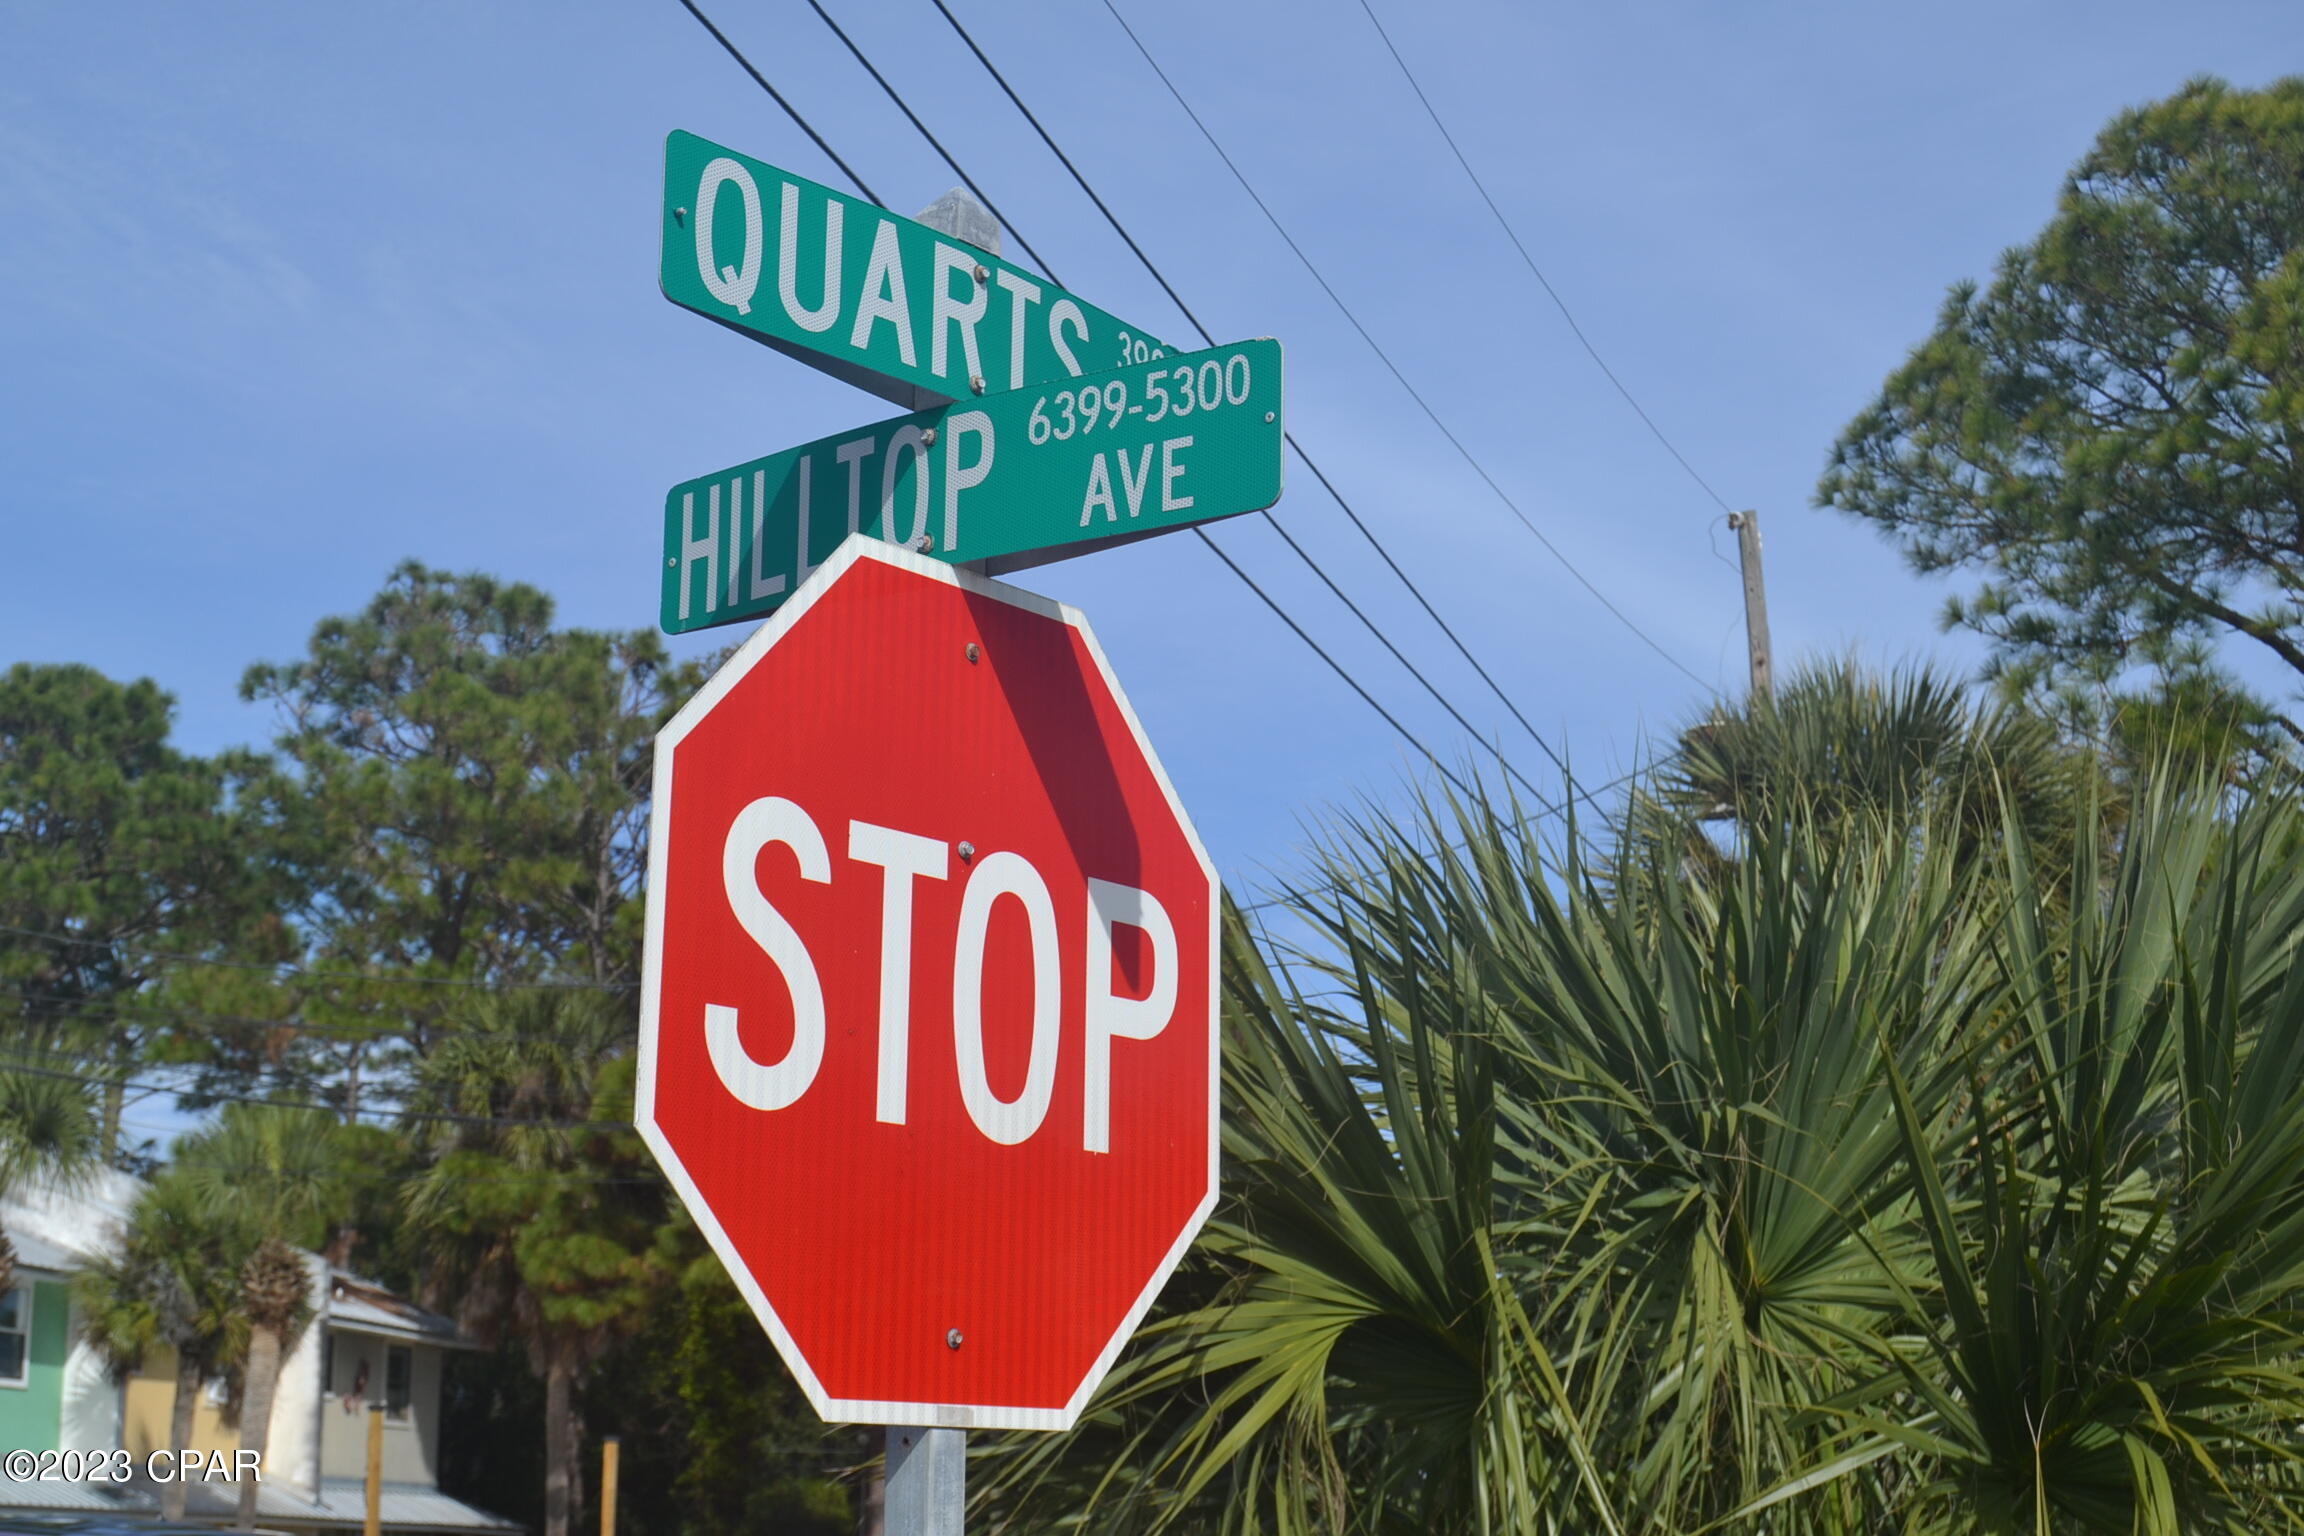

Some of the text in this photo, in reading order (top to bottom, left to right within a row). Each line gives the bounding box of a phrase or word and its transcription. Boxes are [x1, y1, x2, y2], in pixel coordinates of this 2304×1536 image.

[694, 156, 1090, 391] QUARTS
[1027, 353, 1251, 446] 6399-5300
[1078, 434, 1195, 527] AVE
[678, 410, 996, 621] HILLTOP
[704, 796, 1179, 1155] STOP
